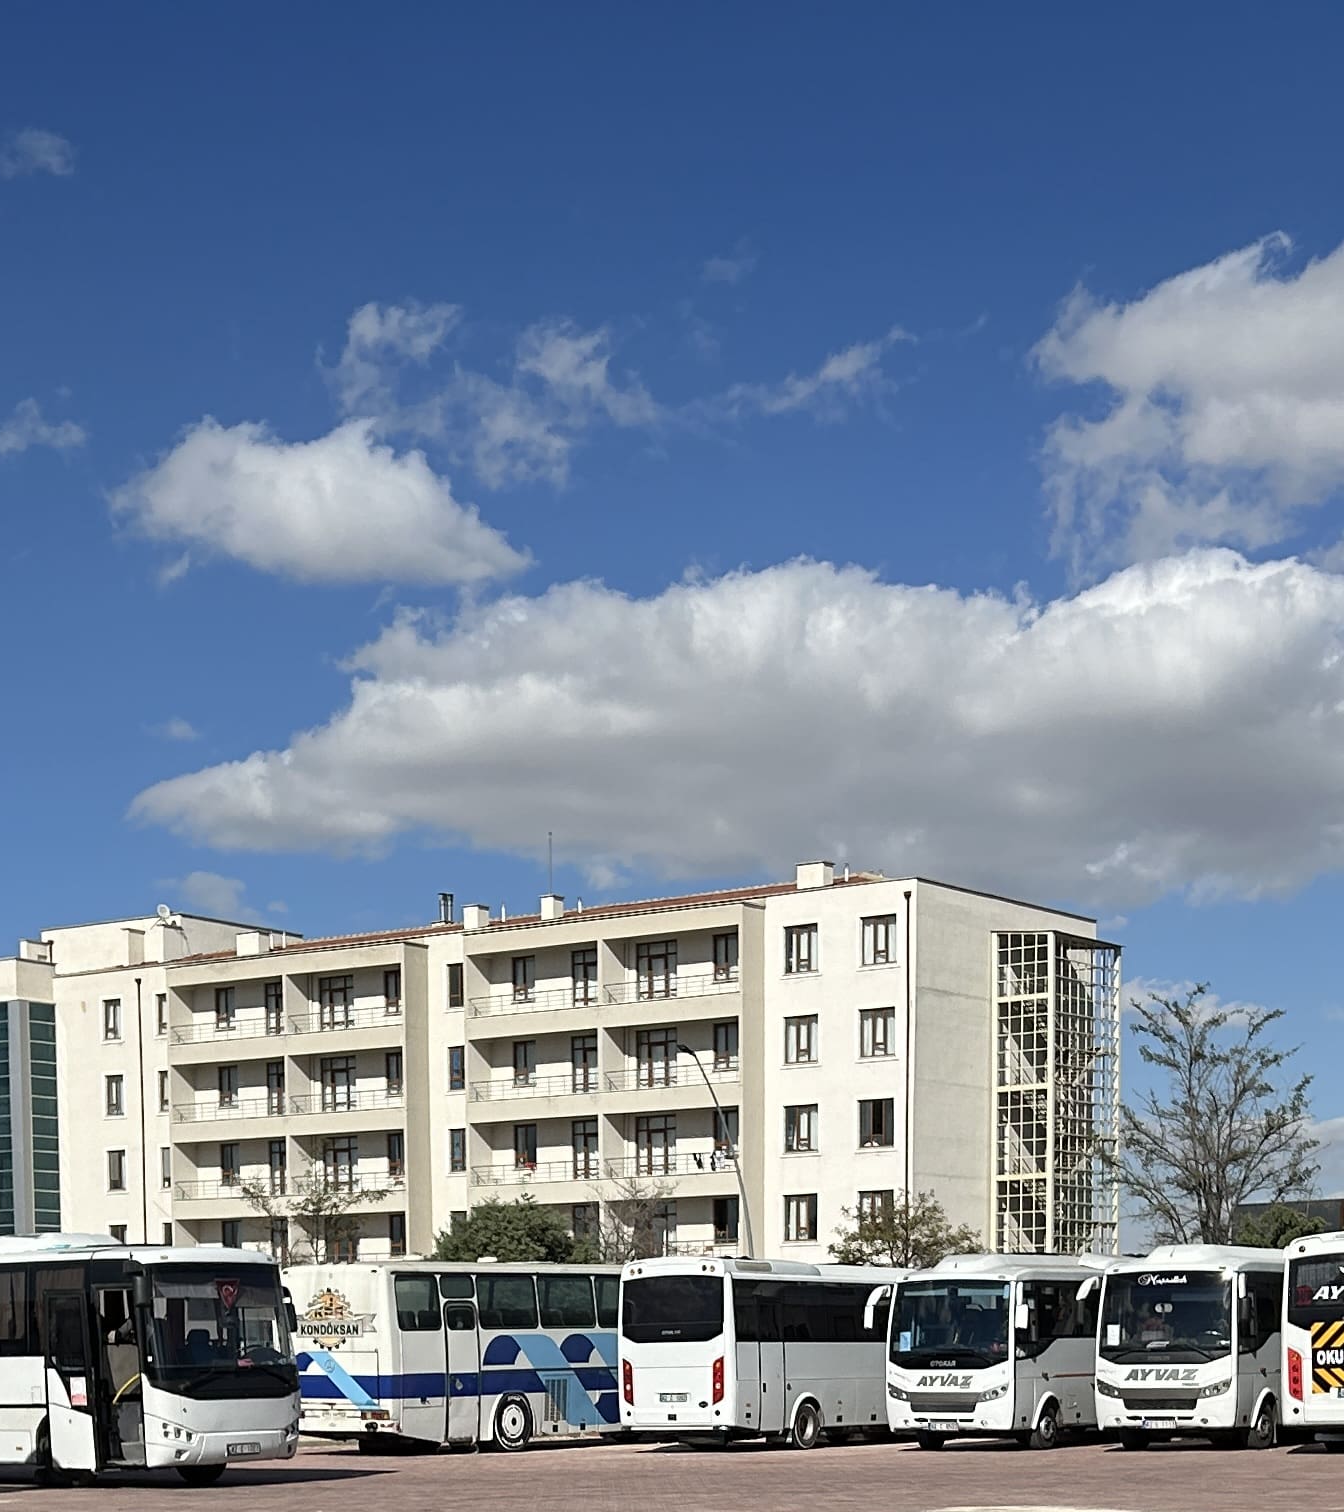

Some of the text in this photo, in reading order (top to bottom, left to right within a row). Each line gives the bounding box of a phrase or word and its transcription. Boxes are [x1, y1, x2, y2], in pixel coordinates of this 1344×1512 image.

[300, 1322, 359, 1336] KONDÖKSAN
[916, 1373, 974, 1387] AYVAZ
[1124, 1368, 1199, 1381] AYVAZ
